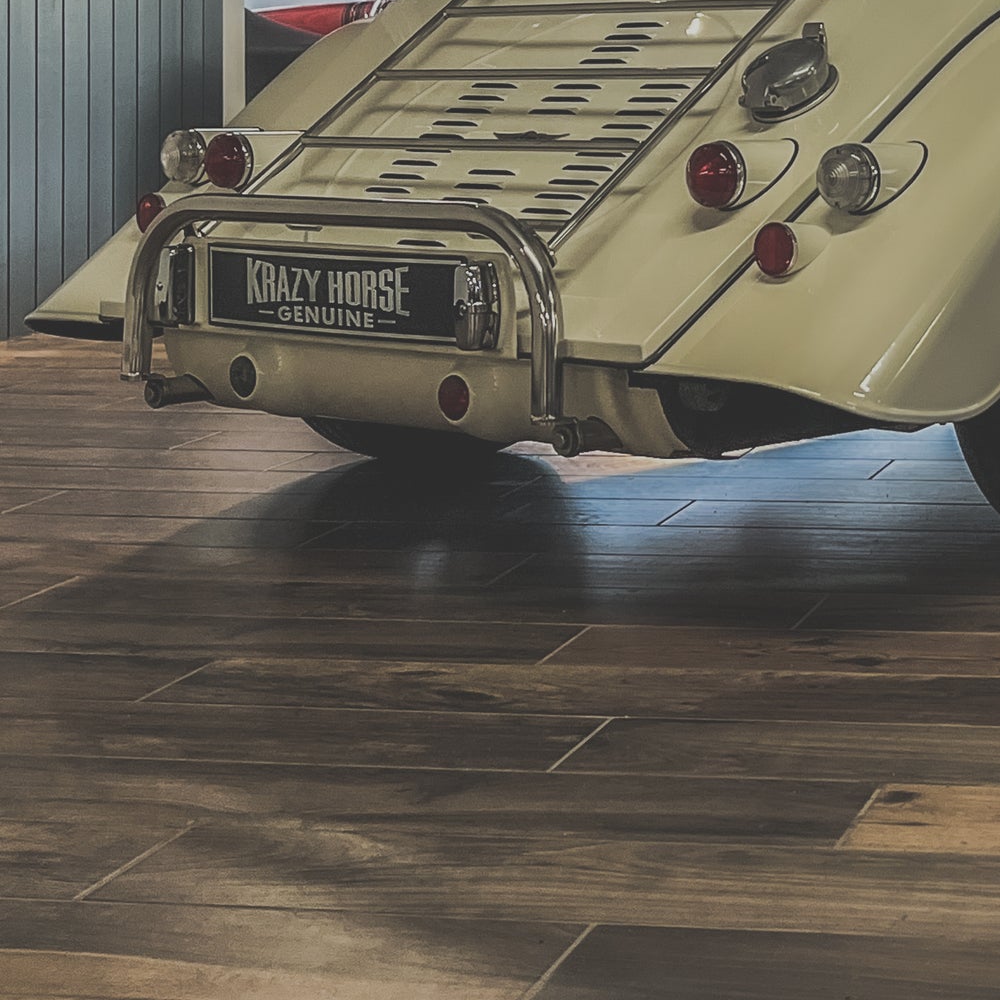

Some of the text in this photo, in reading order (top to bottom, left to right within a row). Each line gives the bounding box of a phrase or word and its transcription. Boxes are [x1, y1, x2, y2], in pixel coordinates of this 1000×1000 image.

[246, 257, 410, 317] KRAZY HORSE
[277, 305, 375, 328] GENUINE
